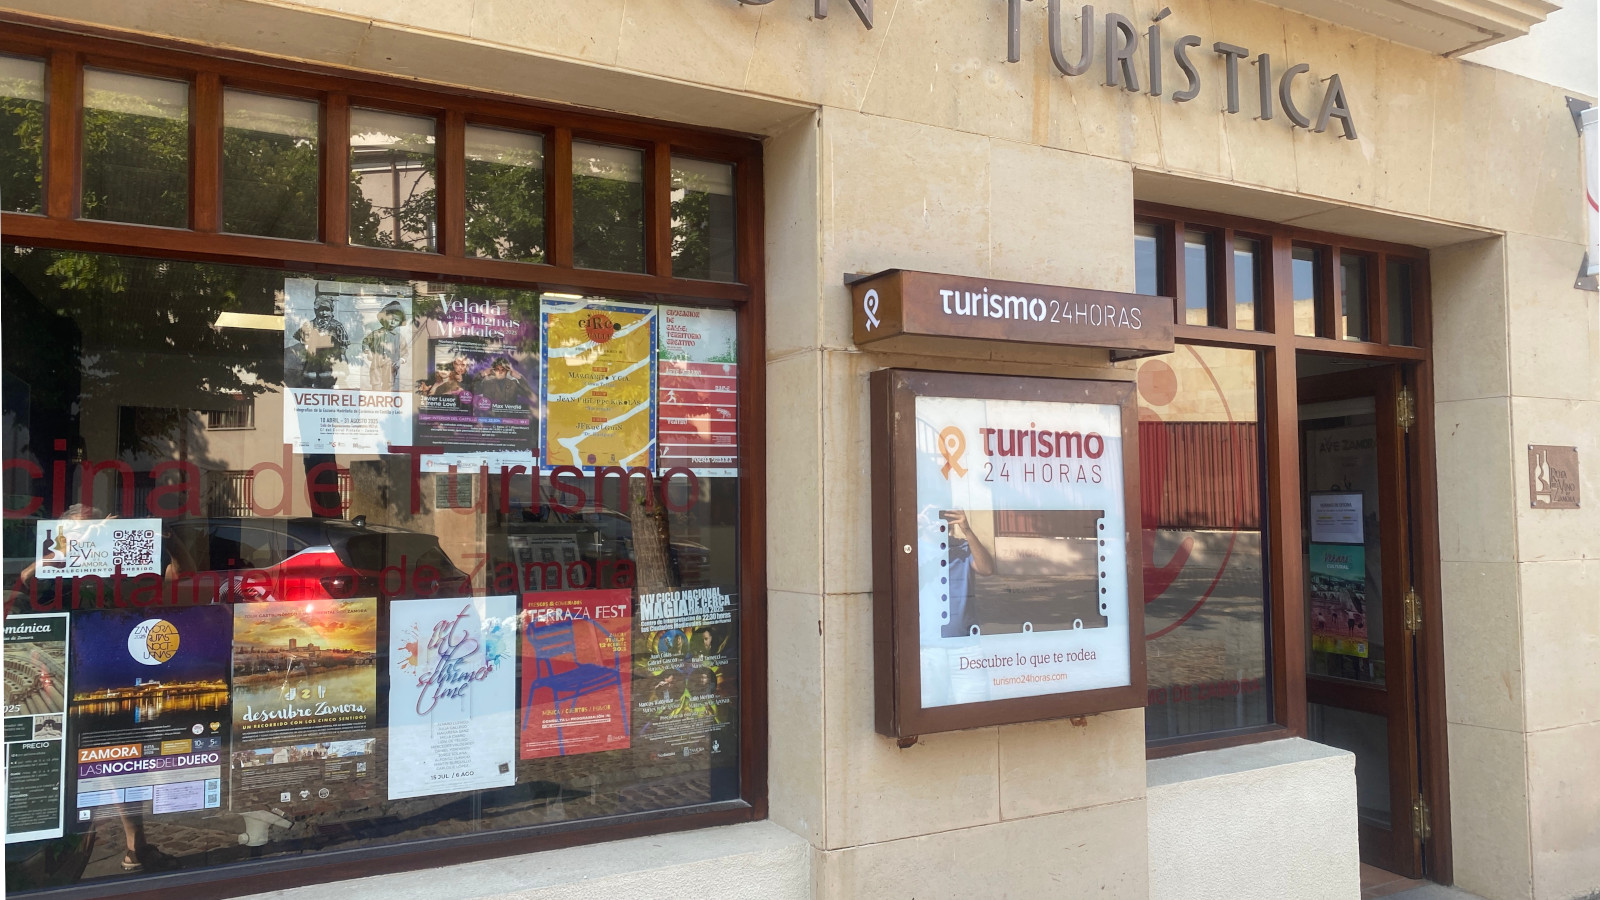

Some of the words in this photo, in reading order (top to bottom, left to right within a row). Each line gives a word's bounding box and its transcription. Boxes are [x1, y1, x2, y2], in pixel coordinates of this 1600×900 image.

[438, 293, 501, 315] Velada
[436, 320, 505, 338] Mentales
[464, 311, 520, 328] Enigmas
[294, 392, 340, 406] VESTIR
[342, 394, 357, 407] EL
[358, 394, 404, 408] BARRO
[979, 421, 1105, 459] turismo
[244, 443, 354, 518] de
[388, 446, 699, 515] Turismo
[984, 462, 1010, 482] 24
[1024, 463, 1102, 484] HORAS
[379, 554, 440, 597] de
[459, 552, 636, 595] Zamora
[655, 591, 681, 603] CICLO
[681, 586, 721, 600] NACIONAL
[527, 606, 591, 622] TERRAZA
[595, 604, 627, 619] FEST
[640, 599, 689, 621] MAGIA
[701, 594, 731, 608] CERCA
[959, 654, 1014, 671] Descubre
[1016, 652, 1026, 667] lo
[1029, 652, 1051, 668] que
[1053, 650, 1064, 663] te
[1066, 648, 1097, 662] rodea
[993, 671, 1068, 687] turismo24horas.com
[242, 704, 313, 722] descubre
[314, 701, 367, 716] Zamora
[22, 741, 50, 750] PRECIO
[80, 745, 139, 762] ZAMORA
